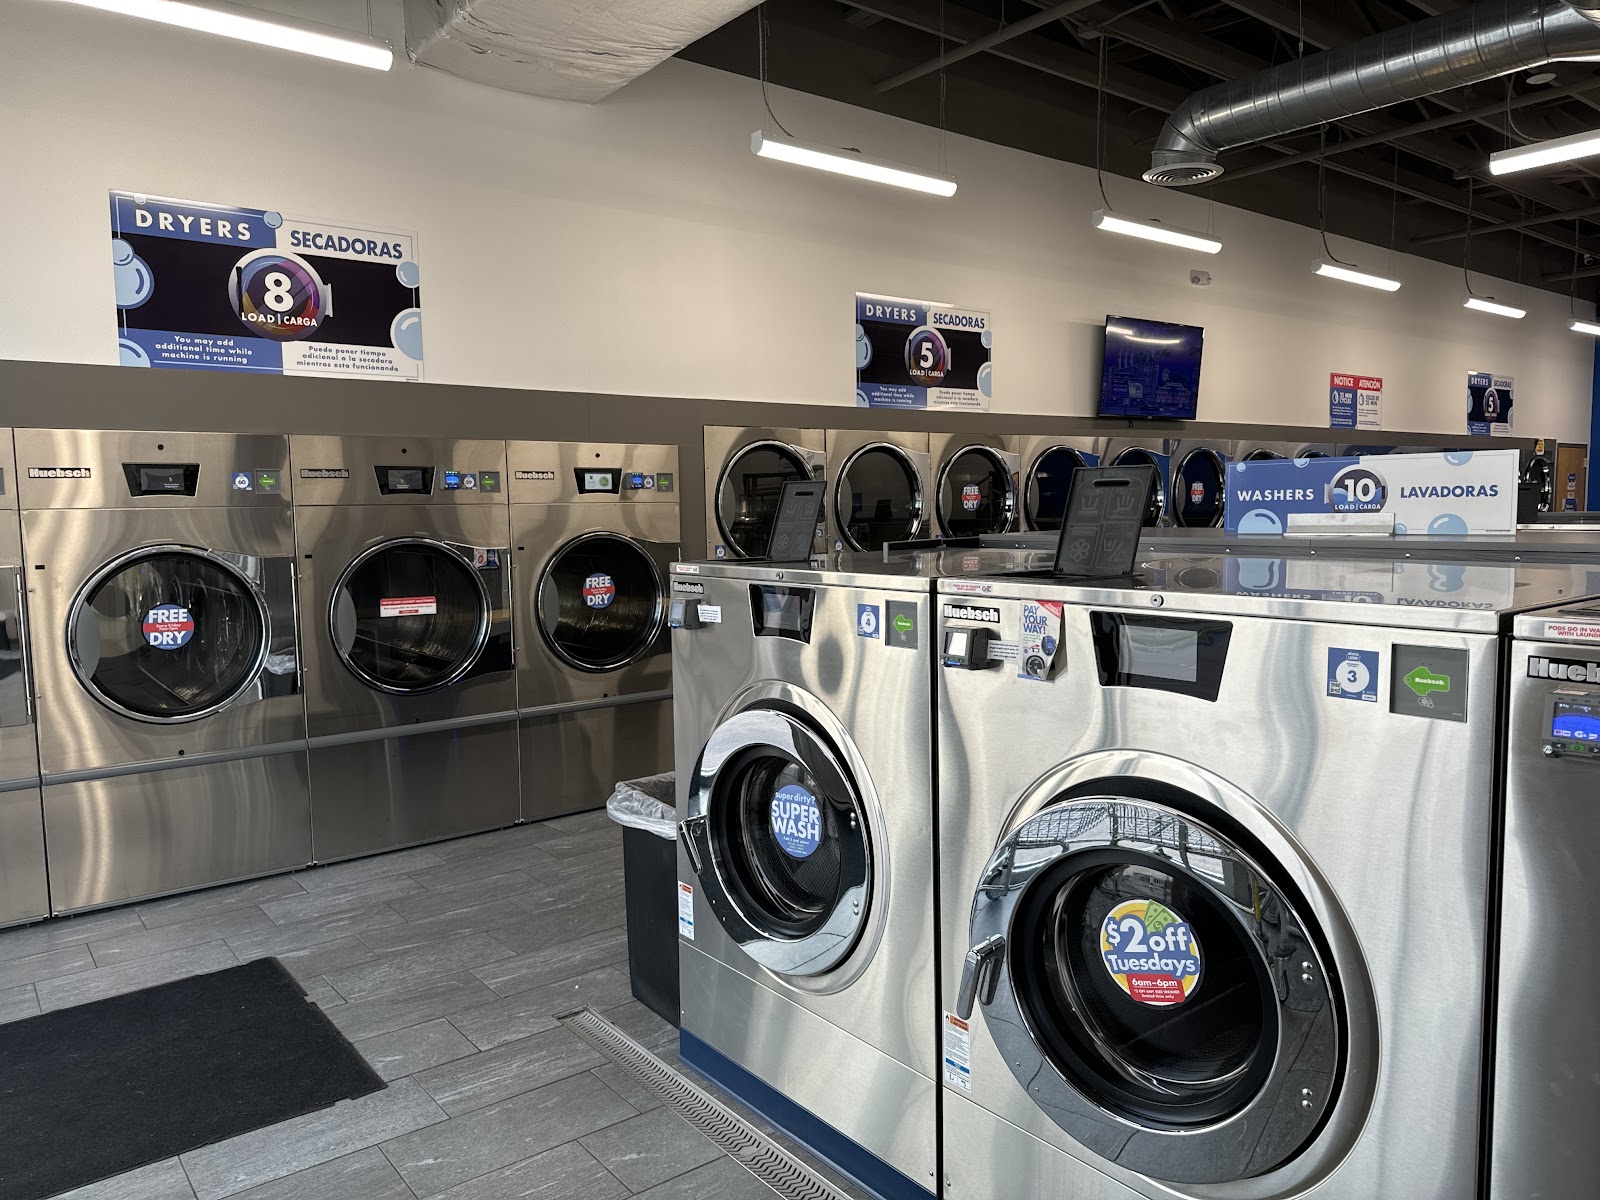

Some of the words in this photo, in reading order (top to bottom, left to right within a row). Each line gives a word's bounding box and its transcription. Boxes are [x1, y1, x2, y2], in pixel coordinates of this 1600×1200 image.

[135, 209, 251, 241] DRYERS
[290, 230, 403, 260] SECADORAS
[264, 271, 294, 312] 8
[241, 312, 276, 323] LOAD
[283, 316, 318, 327] CARGA
[866, 304, 916, 322] DRYERS
[933, 312, 985, 329] SECADORAS
[174, 336, 191, 344] You
[194, 338, 214, 346] may
[216, 338, 234, 346] add
[155, 342, 202, 352] additional
[206, 346, 226, 354] time
[228, 348, 252, 356] while
[308, 345, 332, 353] Puede
[335, 348, 358, 356] poner
[360, 348, 386, 358] tiempo
[920, 342, 934, 368] 5
[162, 352, 200, 360] machine
[214, 355, 248, 364] running
[302, 352, 338, 361] adicional
[359, 356, 393, 364] secadora
[296, 360, 331, 368] mientras
[352, 363, 399, 372] funcionando
[909, 368, 925, 376] LOAD
[928, 368, 944, 378] CARGA
[1334, 376, 1354, 387] NOTICE
[1488, 396, 1494, 412] 5
[29, 468, 90, 478] Huebsch
[301, 469, 349, 478] Huebsch
[963, 486, 979, 495] FREE
[1237, 488, 1314, 501] WASHERS
[1344, 478, 1376, 502] 10
[1400, 484, 1499, 498] LAVADORAS
[964, 500, 978, 509] DRY
[586, 576, 611, 588] FREE
[674, 582, 703, 593] Huebsch
[587, 594, 610, 606] DRY
[148, 608, 188, 624] FREE
[944, 605, 998, 622] Huebsch
[1023, 604, 1040, 616] PAY
[866, 618, 871, 626] 4
[1023, 614, 1048, 626] YOUR
[1023, 623, 1046, 635] WAY!
[150, 630, 186, 646] DRY
[1347, 670, 1357, 683] 3
[775, 792, 793, 802] super
[794, 792, 816, 805] dirty?
[772, 800, 820, 825] SUPER
[772, 816, 819, 842] WASH
[1107, 918, 1148, 952] $2
[1149, 927, 1188, 951] off
[1108, 953, 1196, 976] Tuesdays
